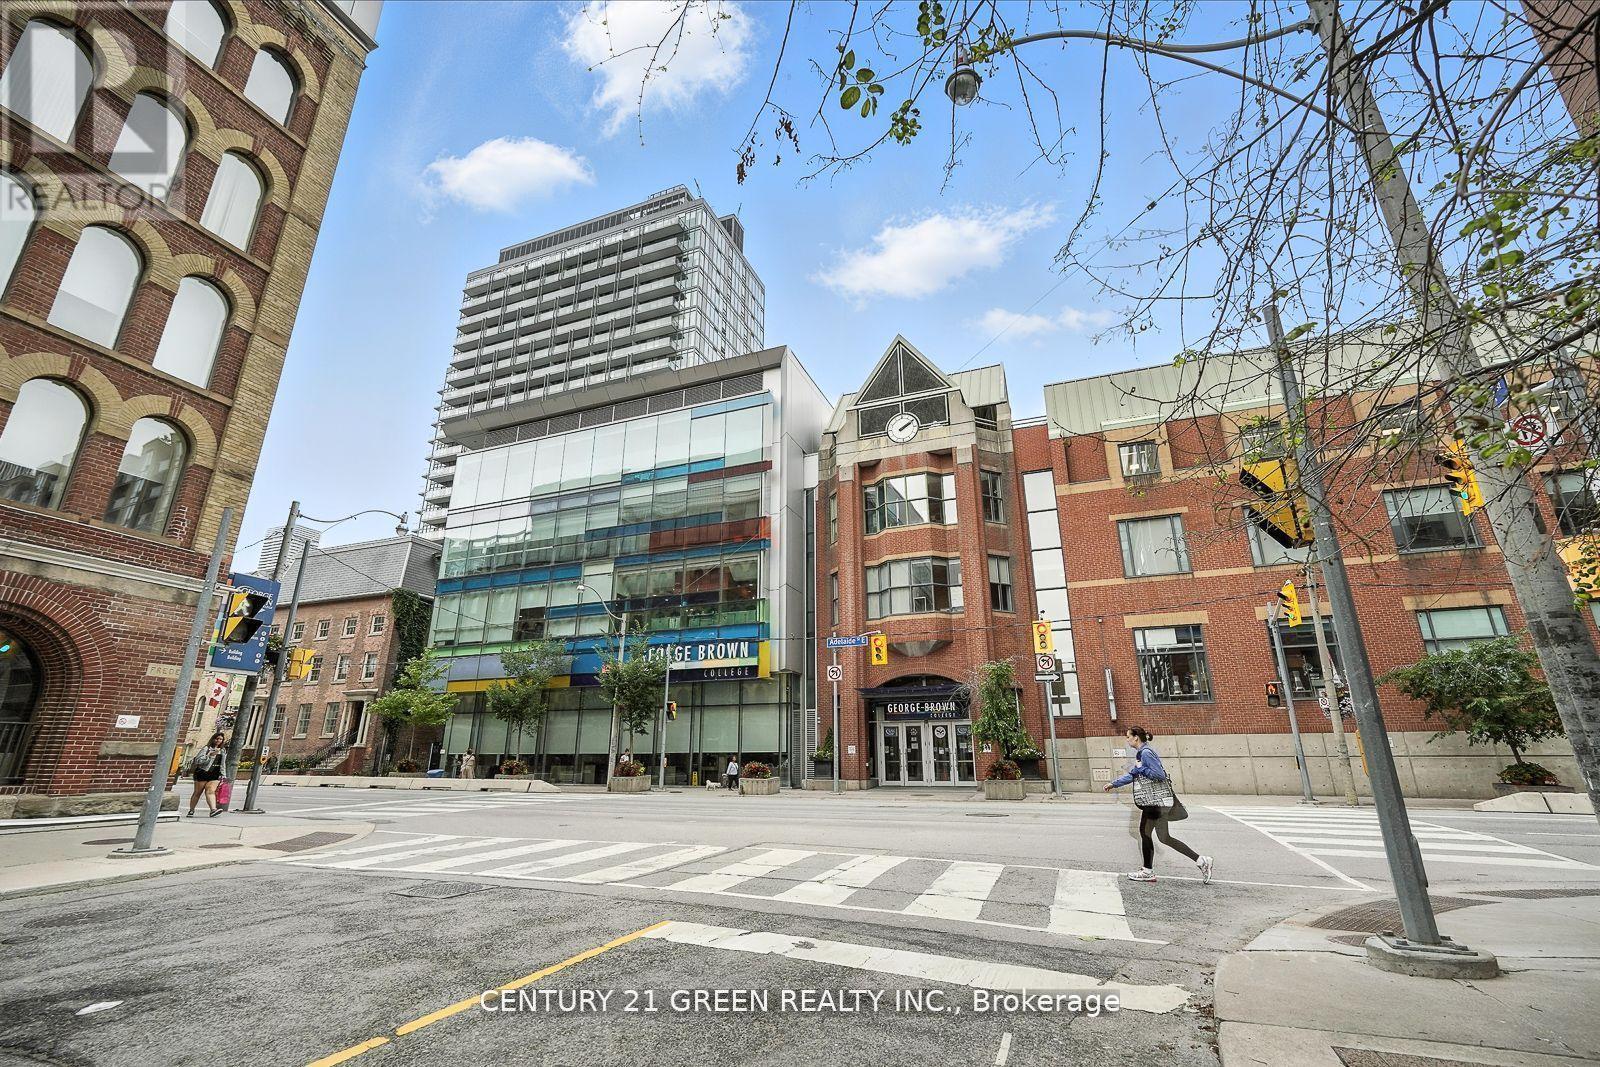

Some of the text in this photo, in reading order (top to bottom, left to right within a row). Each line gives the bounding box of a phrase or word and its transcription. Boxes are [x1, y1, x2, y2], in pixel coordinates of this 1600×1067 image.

[829, 638, 856, 646] Adelaide
[861, 636, 866, 644] E
[698, 641, 749, 660] BROWN
[703, 667, 749, 678] COLLEGE
[887, 702, 920, 713] GEORGE
